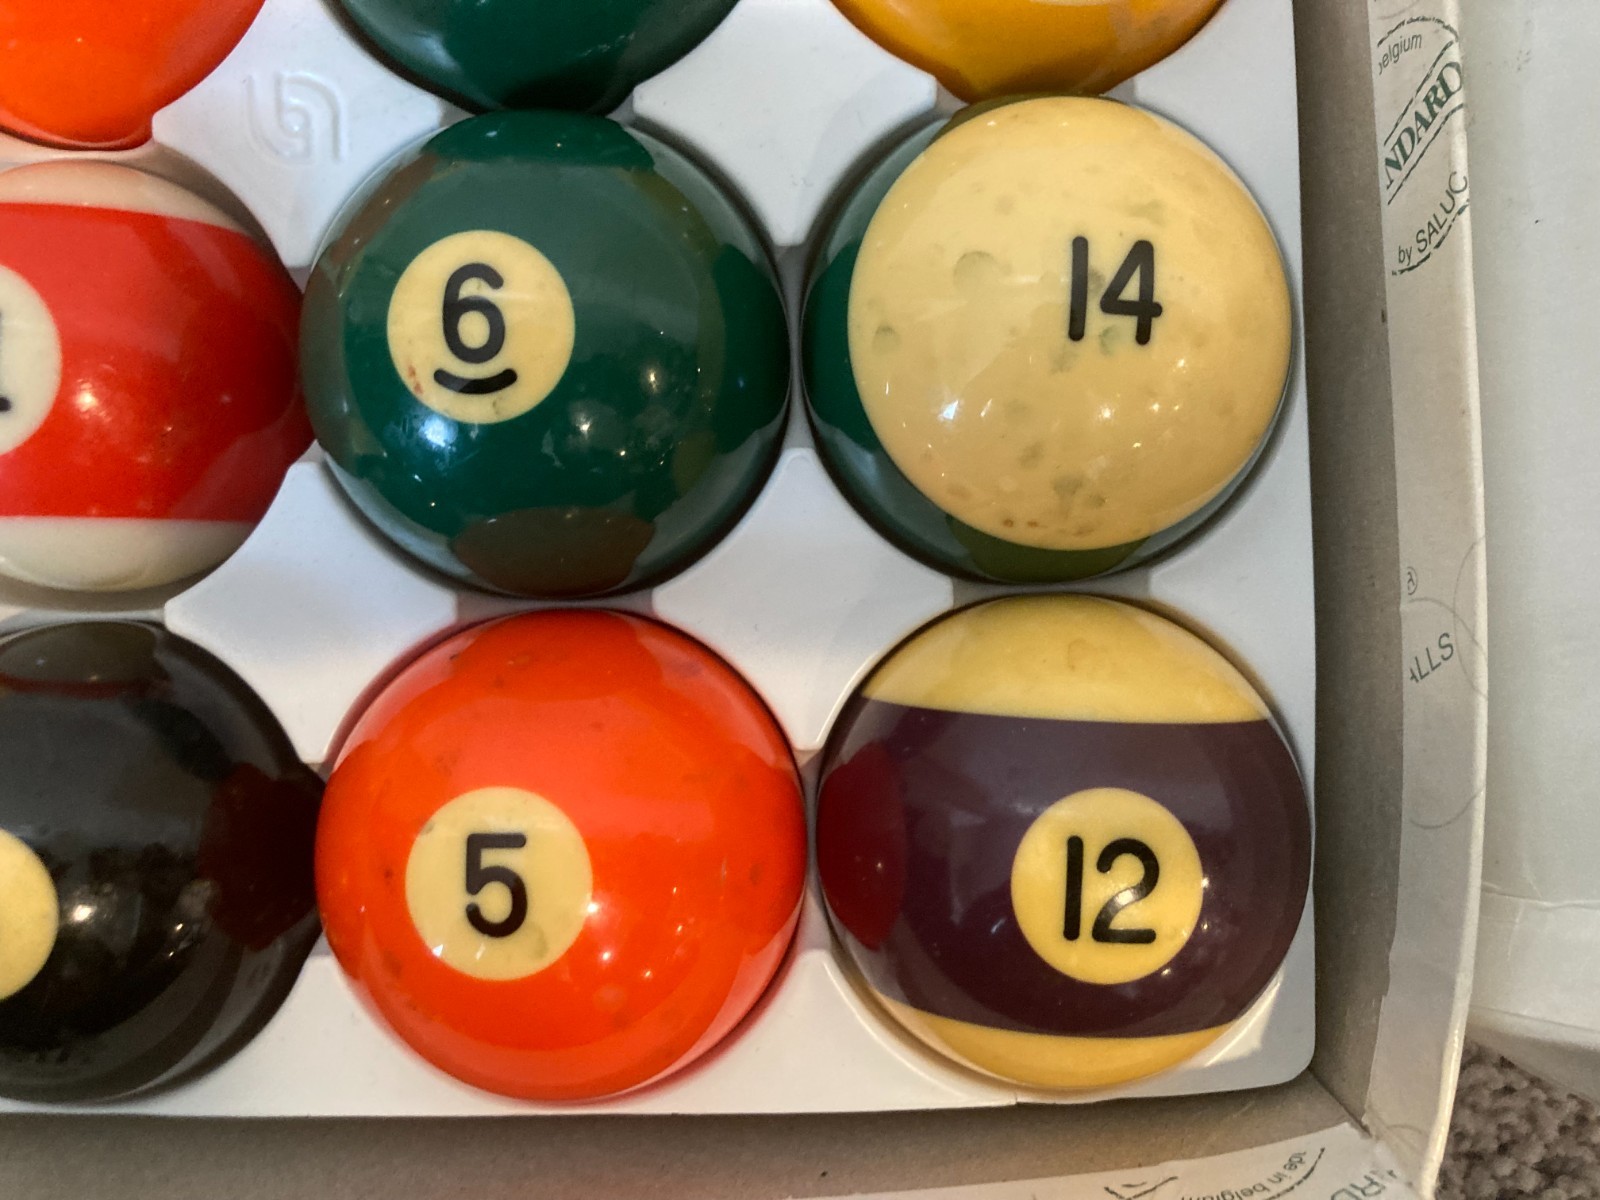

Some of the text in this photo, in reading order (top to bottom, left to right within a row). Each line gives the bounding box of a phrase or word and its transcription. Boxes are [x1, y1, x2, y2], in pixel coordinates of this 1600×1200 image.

[1398, 171, 1468, 267] by SALUC
[442, 262, 505, 364] 6
[1068, 236, 1163, 346] 14
[465, 833, 528, 938] 5
[1063, 835, 1160, 945] 12
[1283, 1151, 1307, 1171] de
